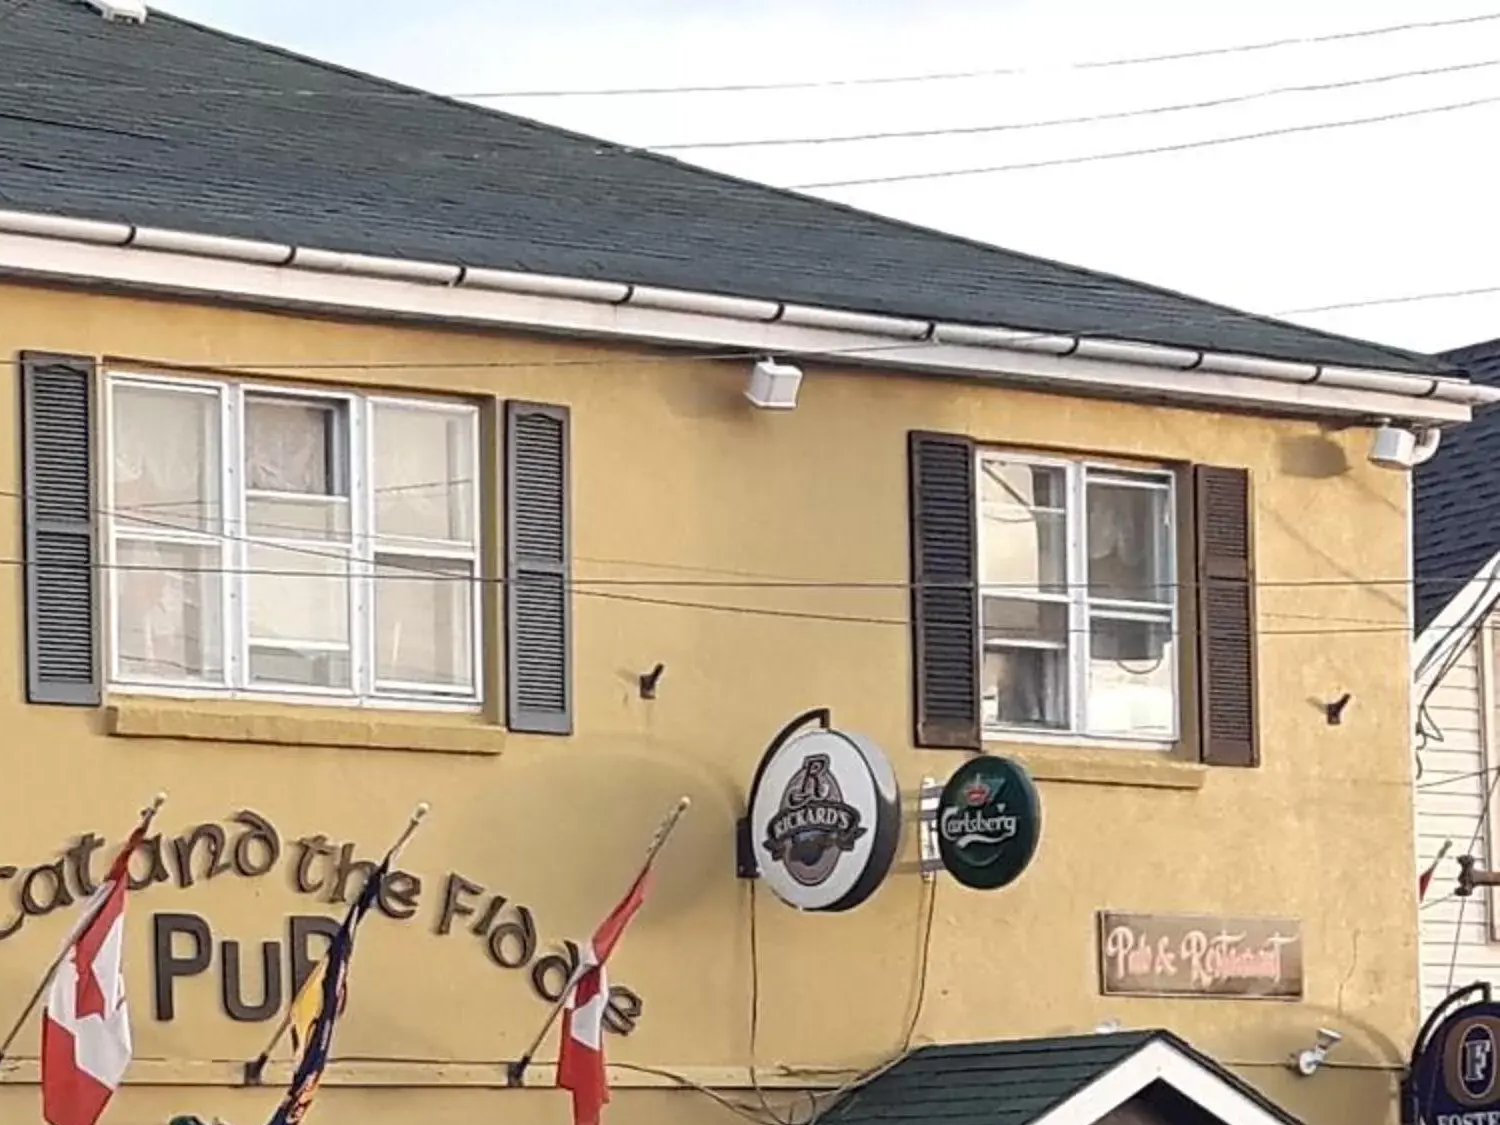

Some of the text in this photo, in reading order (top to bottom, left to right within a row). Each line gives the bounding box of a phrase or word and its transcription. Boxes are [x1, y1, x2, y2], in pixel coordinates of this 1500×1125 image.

[941, 804, 1017, 848] Carlsberg
[292, 834, 422, 920] the
[1181, 929, 1298, 987] Restt
